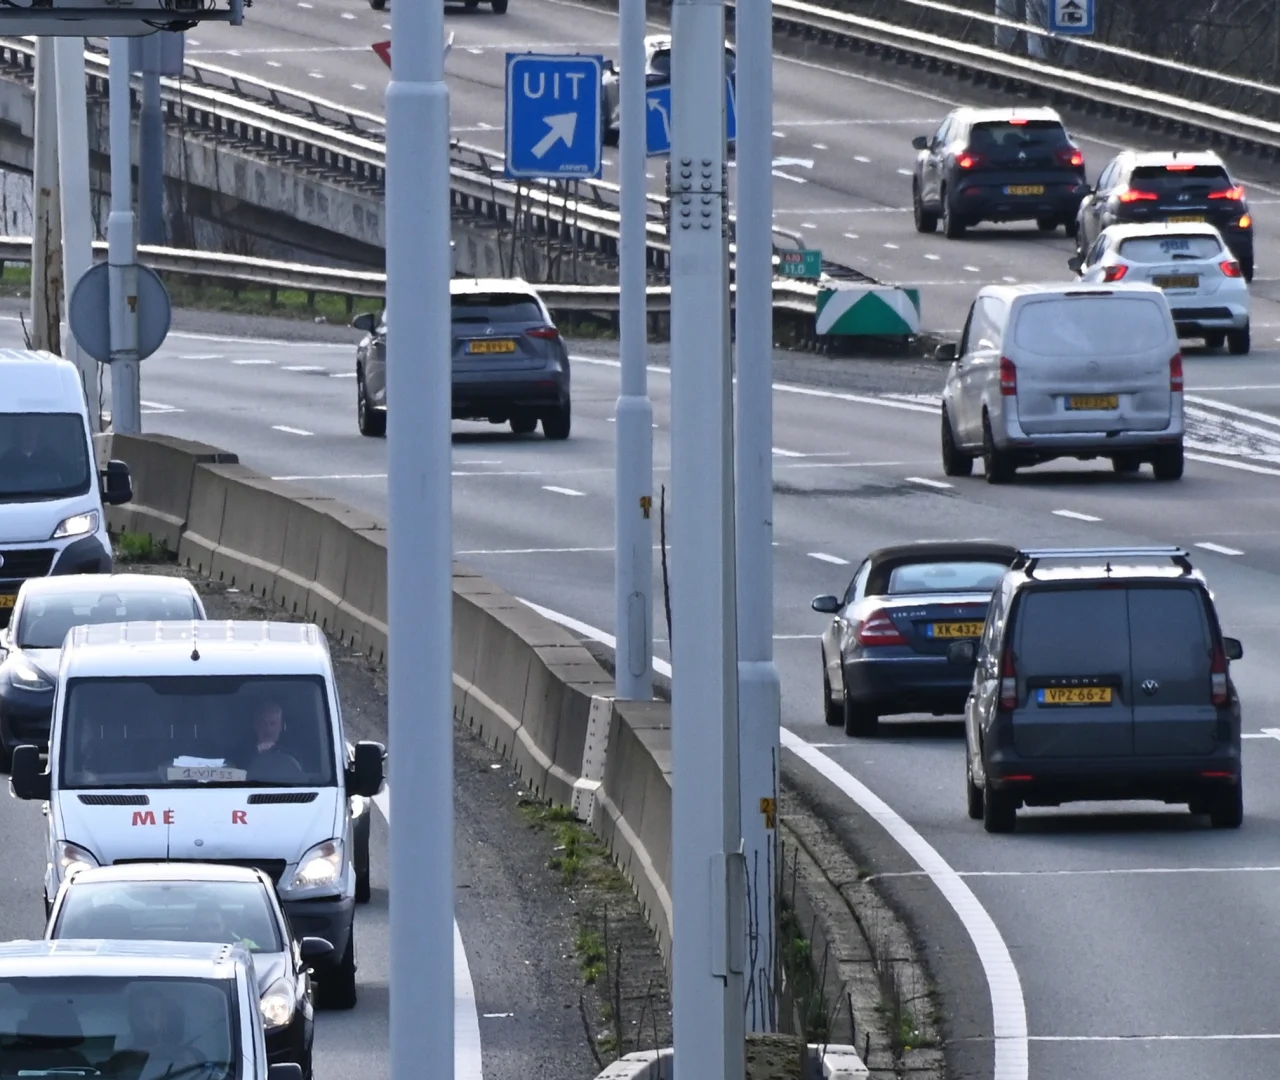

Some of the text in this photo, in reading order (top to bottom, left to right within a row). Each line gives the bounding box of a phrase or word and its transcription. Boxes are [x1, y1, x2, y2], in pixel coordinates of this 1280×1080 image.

[524, 72, 585, 100] UIT
[937, 623, 983, 636] XK-432-
[1050, 691, 1107, 701] VPZ-66-Z
